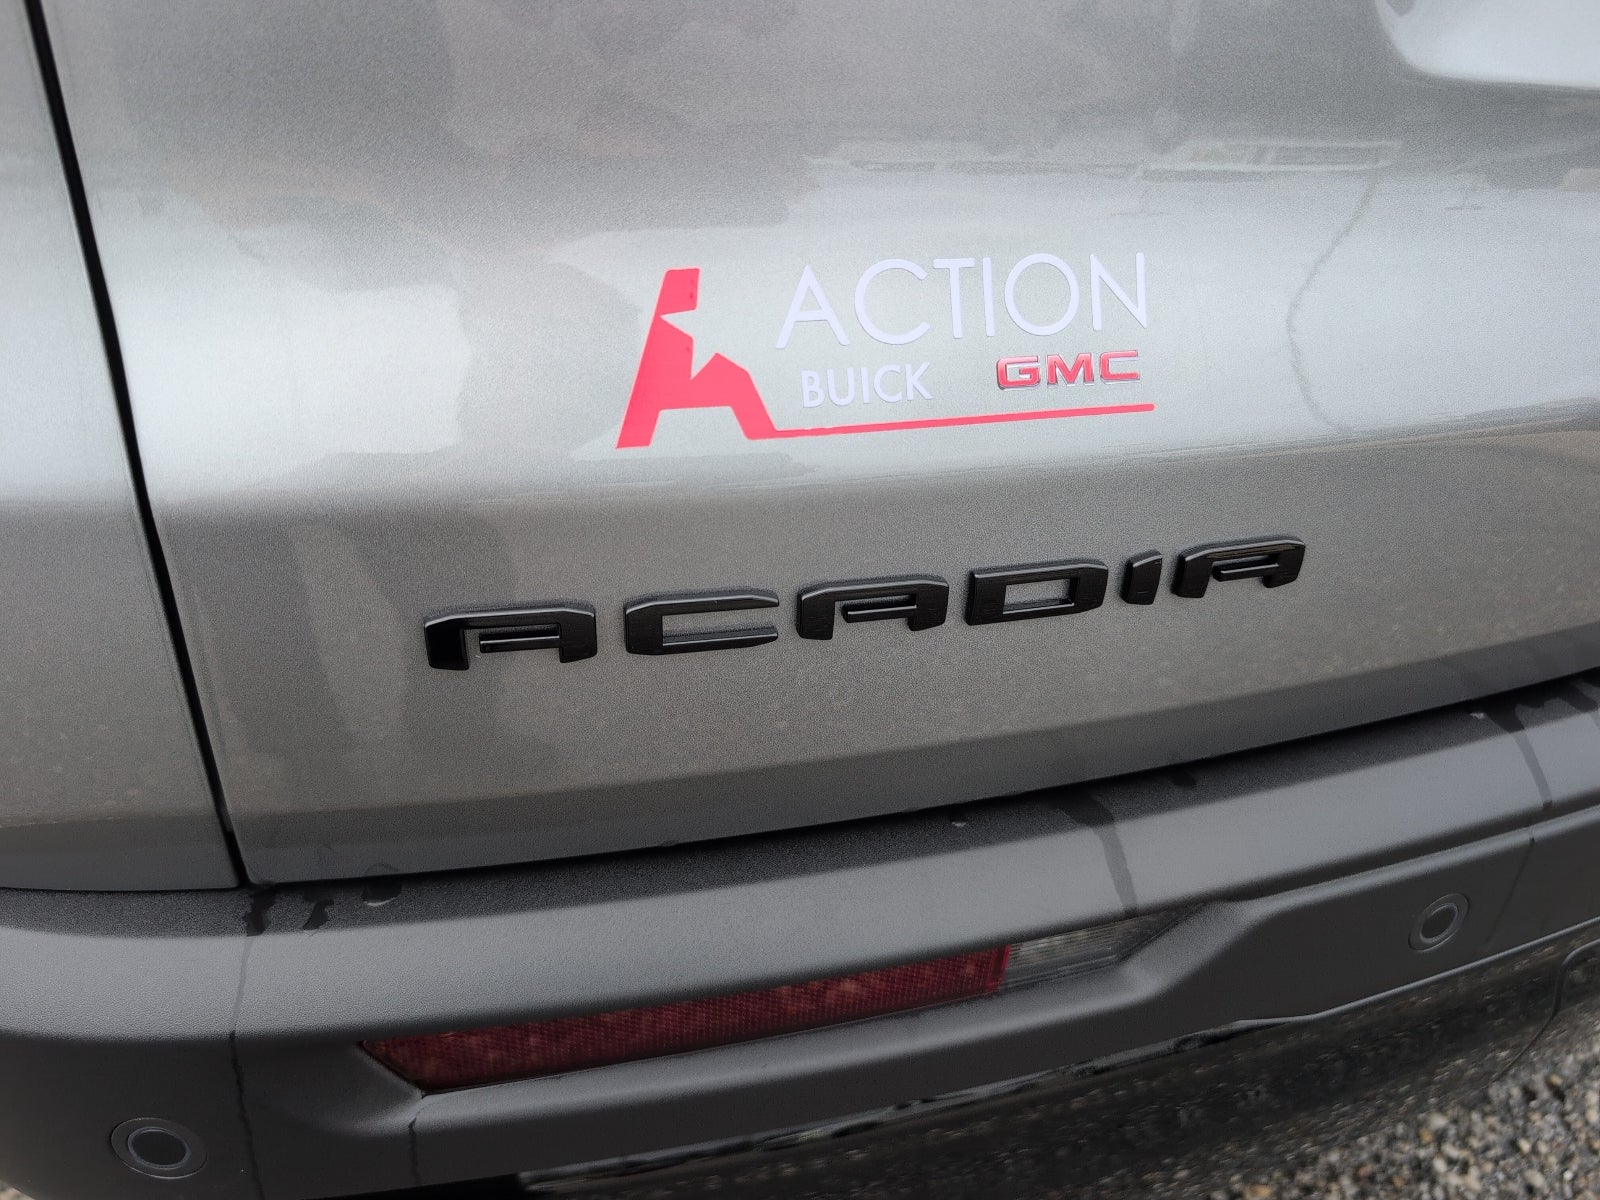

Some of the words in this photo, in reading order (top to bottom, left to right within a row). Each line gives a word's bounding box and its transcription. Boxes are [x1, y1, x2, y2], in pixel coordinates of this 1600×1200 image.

[775, 252, 1149, 350] ACTION
[800, 362, 933, 409] BUICK
[996, 349, 1140, 390] GMC
[423, 535, 1307, 671] ACADIA
